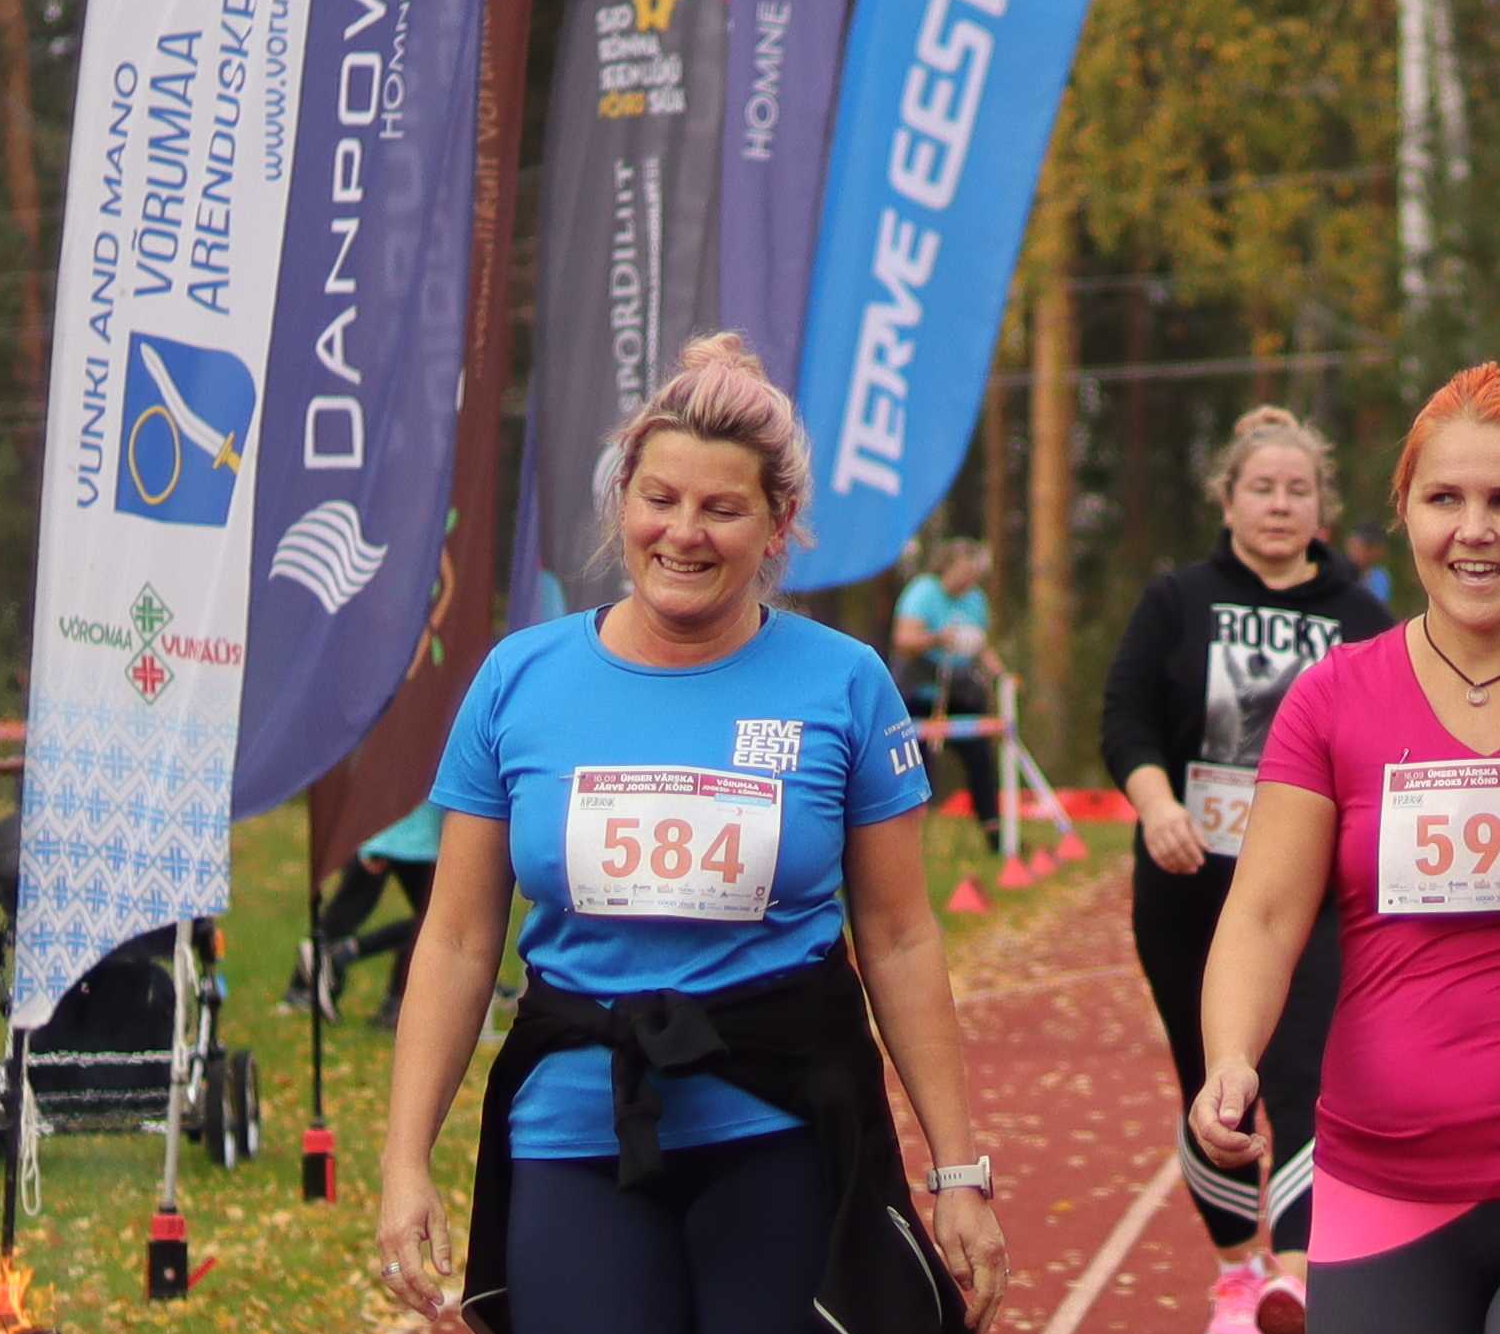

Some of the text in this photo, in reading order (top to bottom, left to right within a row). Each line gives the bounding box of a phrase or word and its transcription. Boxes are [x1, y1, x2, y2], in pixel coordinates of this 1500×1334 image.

[133, 28, 203, 298] VÕRUMAA
[77, 60, 140, 509] VUNKI AND MANO
[834, 207, 942, 497] TERVE
[736, 720, 803, 738] TERVE
[735, 736, 800, 754] EESTI
[733, 751, 797, 772] EEST!
[620, 773, 652, 783] ÜMBER
[654, 772, 694, 784] VÄRSKA
[1427, 769, 1458, 778] ÜMBER
[1433, 778, 1462, 787] JOOKS
[1470, 776, 1498, 786] KÕND
[593, 783, 624, 792] JÄRVE
[626, 783, 657, 792] JOOKS
[664, 781, 694, 793] KÕND
[601, 817, 744, 884] 584
